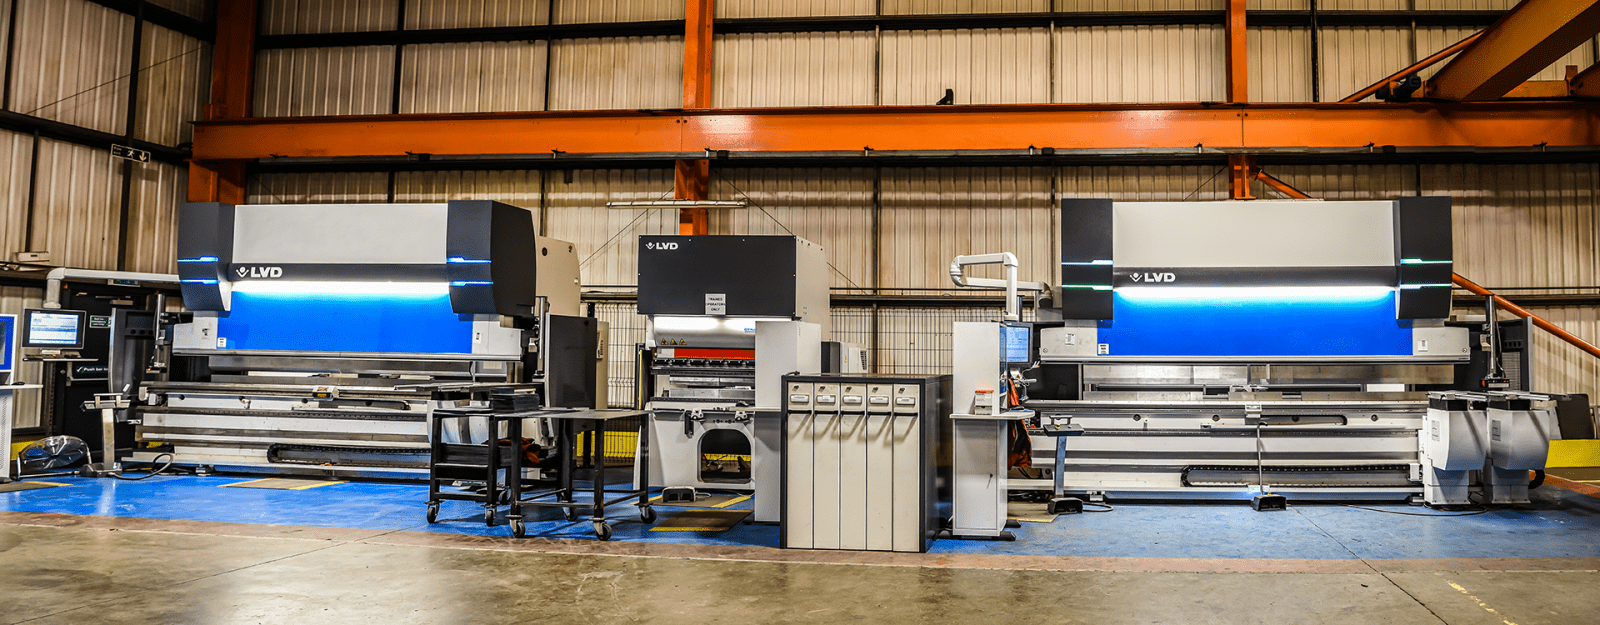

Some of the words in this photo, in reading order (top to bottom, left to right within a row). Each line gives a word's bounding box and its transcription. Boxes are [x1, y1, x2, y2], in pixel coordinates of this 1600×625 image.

[655, 242, 679, 250] LVD
[250, 266, 283, 277] LVD
[1144, 272, 1176, 282] LVD
